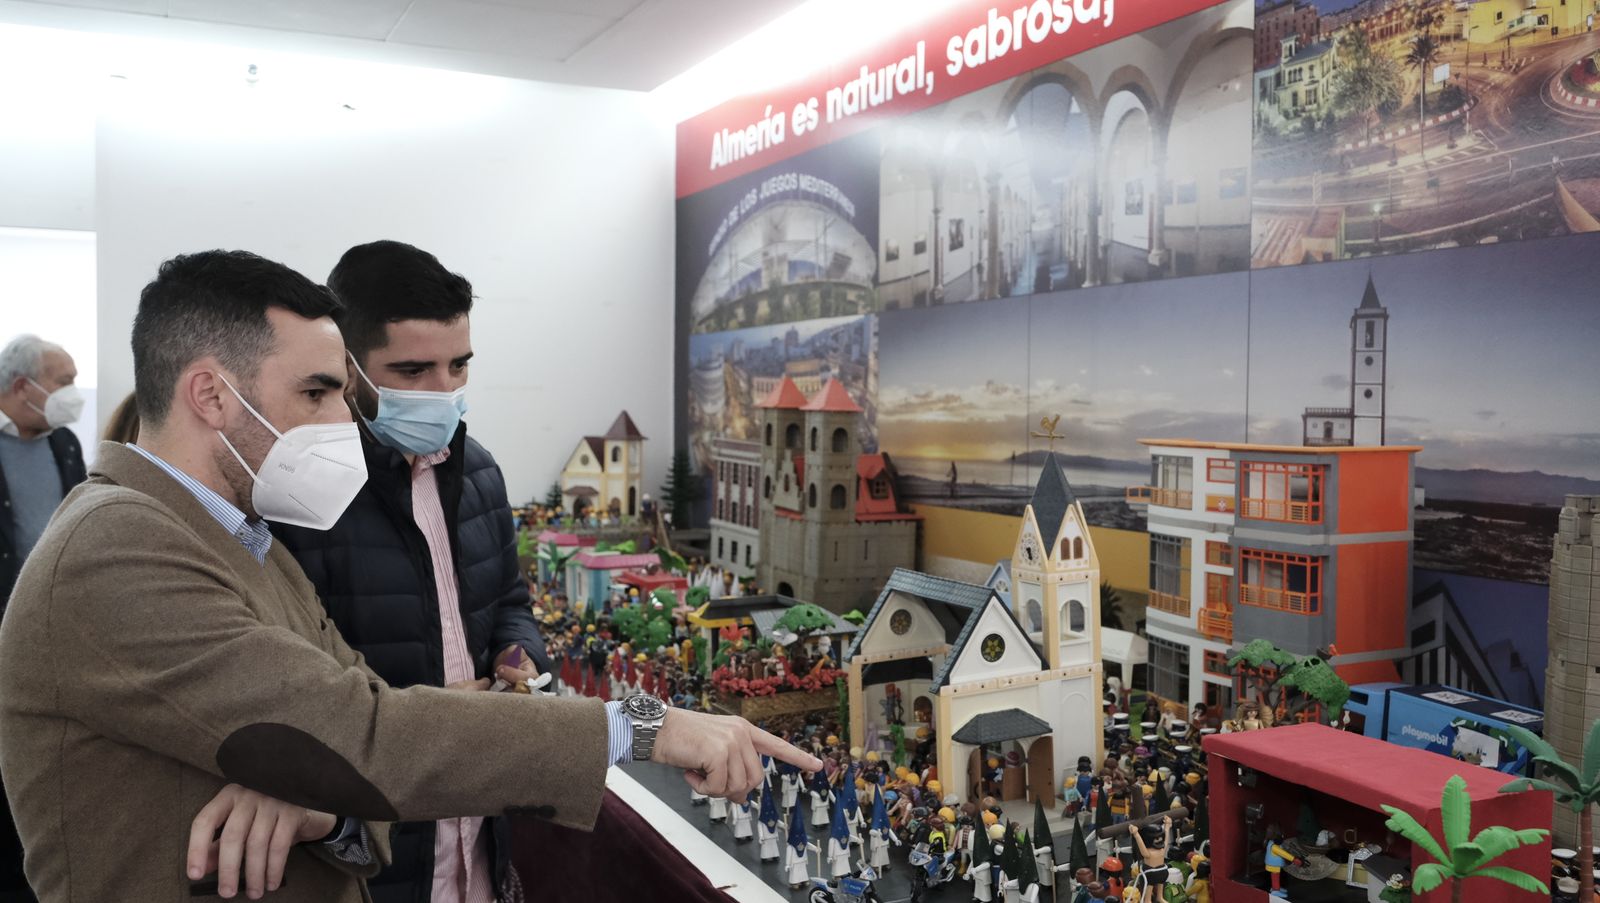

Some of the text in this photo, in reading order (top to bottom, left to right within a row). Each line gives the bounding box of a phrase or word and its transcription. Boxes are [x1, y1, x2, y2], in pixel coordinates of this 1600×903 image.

[710, 104, 785, 169] Almería
[792, 97, 819, 136] es
[826, 40, 934, 123] natural,
[740, 188, 758, 215] LOS
[760, 172, 797, 200] JUEGOS
[1402, 725, 1448, 746] playmobil
